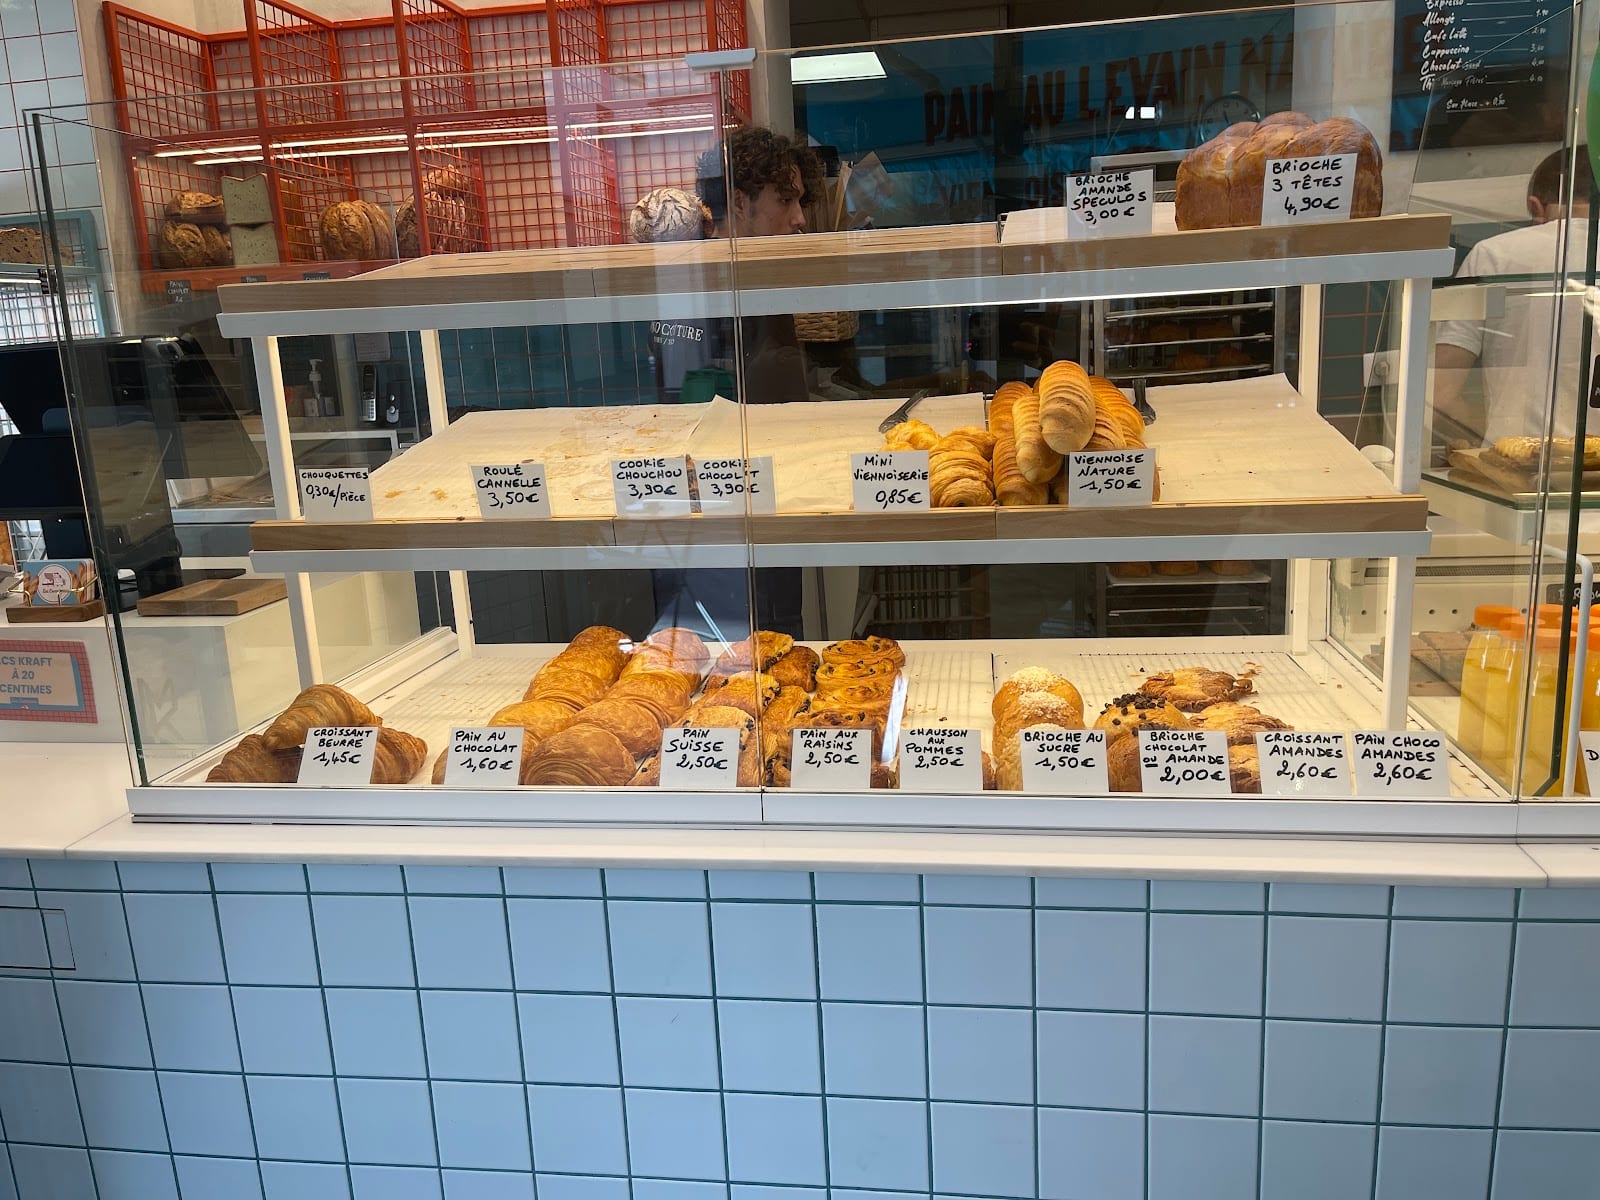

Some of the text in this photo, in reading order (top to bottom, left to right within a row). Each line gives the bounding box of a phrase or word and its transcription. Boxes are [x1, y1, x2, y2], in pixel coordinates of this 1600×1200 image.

[1421, 58, 1462, 75] Chocolat
[1272, 175, 1342, 191] 3 TÊTES
[1079, 183, 1132, 196] AMANDE
[1070, 191, 1147, 211] SPECULOS
[1284, 196, 1340, 216] 4,90€
[864, 453, 893, 467] MINI
[301, 471, 369, 480] CHOUQUETTES
[483, 464, 524, 476] ROULÉ
[616, 468, 682, 480] CHOUCHOU
[699, 470, 760, 480] CHOCOLT
[1077, 465, 1136, 477] NATURE
[477, 477, 541, 489] CANNELLE
[1079, 478, 1142, 494] 1,50€
[627, 484, 678, 499] 3,90€
[487, 492, 540, 509] 3,50€
[875, 489, 923, 510] 0,85€
[0, 657, 53, 666] CS KRAFT
[12, 668, 35, 679] À 20
[0, 684, 53, 694] CENTIMES
[487, 731, 506, 741] AU
[835, 730, 858, 739] AUX
[909, 728, 967, 737] CHAUSSON
[1085, 733, 1103, 743] AU
[318, 738, 364, 748] BEURRE
[927, 736, 945, 745] AUX
[1392, 736, 1440, 748] CHOCO
[454, 744, 517, 753] CHOCOLAT
[905, 743, 964, 755] POMMES
[1037, 743, 1081, 753] SUCRE
[1145, 744, 1207, 752] CHOCOLAT
[1269, 744, 1344, 759] AMANDES
[313, 751, 362, 767] 1,45€
[805, 751, 860, 766] 2,50€
[1165, 753, 1225, 765] AMANDE
[1361, 748, 1436, 763] AMANDES
[460, 757, 513, 773] 1,60€
[676, 755, 729, 770] 2,50€
[914, 755, 965, 769] 2,50€
[1035, 756, 1096, 771] 1,50€
[1159, 766, 1226, 786] 2,00€
[1276, 760, 1338, 781] 2,60€
[1373, 762, 1433, 786] 2,60€
